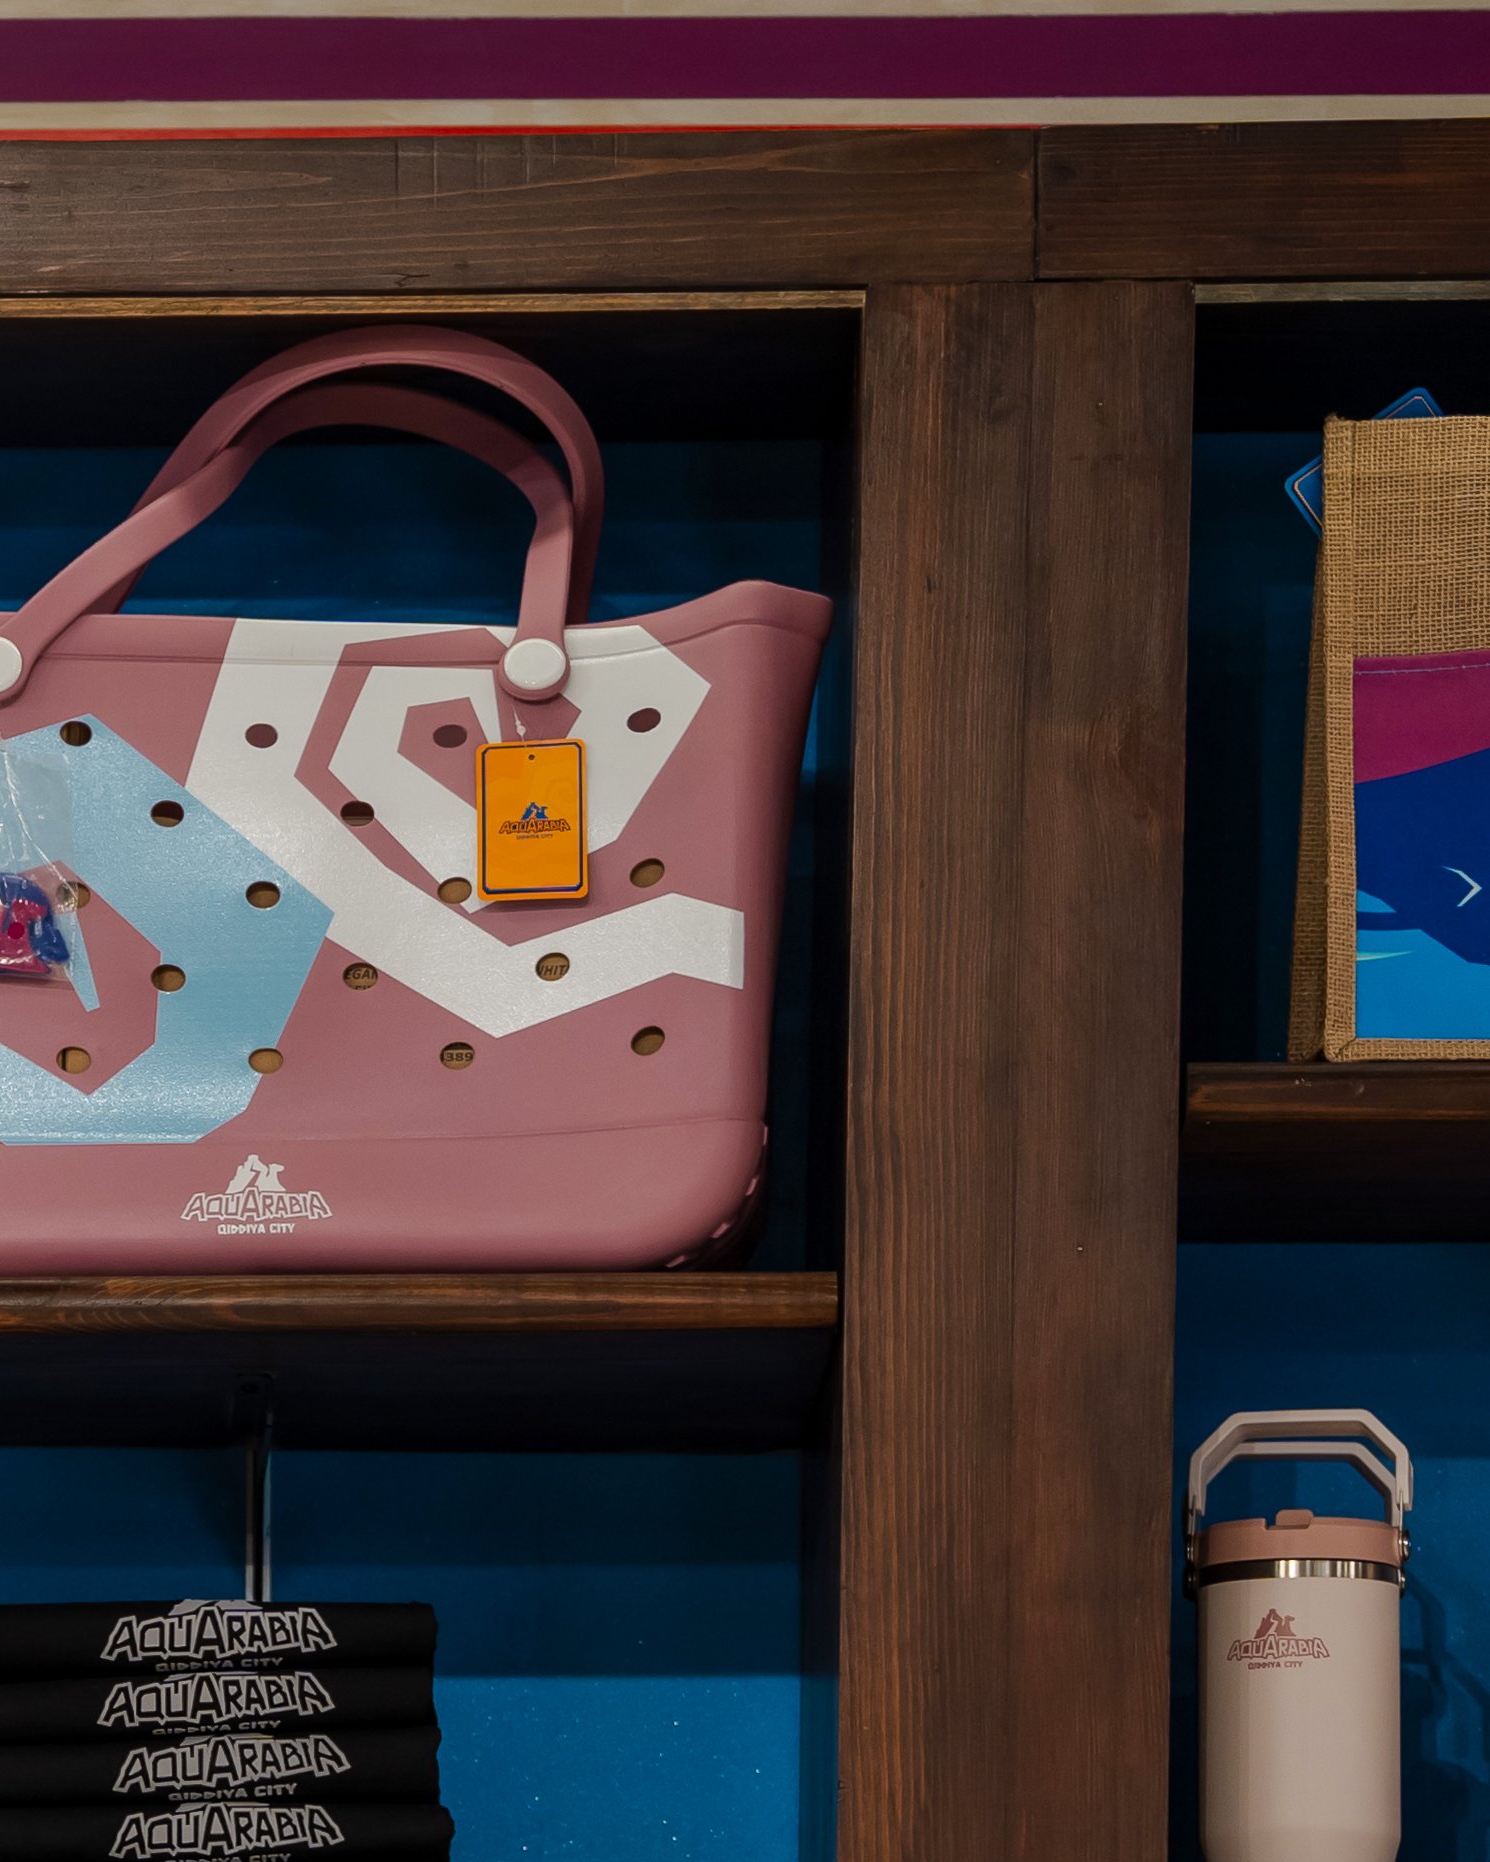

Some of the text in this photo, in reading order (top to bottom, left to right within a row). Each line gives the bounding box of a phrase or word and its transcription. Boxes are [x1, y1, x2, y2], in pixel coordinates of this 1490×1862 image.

[181, 1188, 332, 1222] AQUARABIA
[218, 1224, 295, 1235] QIDDIYA CITY
[100, 1607, 337, 1661] AQUARABIA
[1227, 1634, 1330, 1660] AQUARABIA
[155, 1657, 283, 1673] QIDDIYA CITY
[97, 1672, 335, 1727] AQUARABIA
[239, 1720, 281, 1730] CITY
[113, 1735, 352, 1793] AQUARABIA
[168, 1783, 297, 1800] QIDDIYA CITY
[109, 1802, 345, 1859] AQUARABIA
[249, 1853, 291, 1862] CITY
